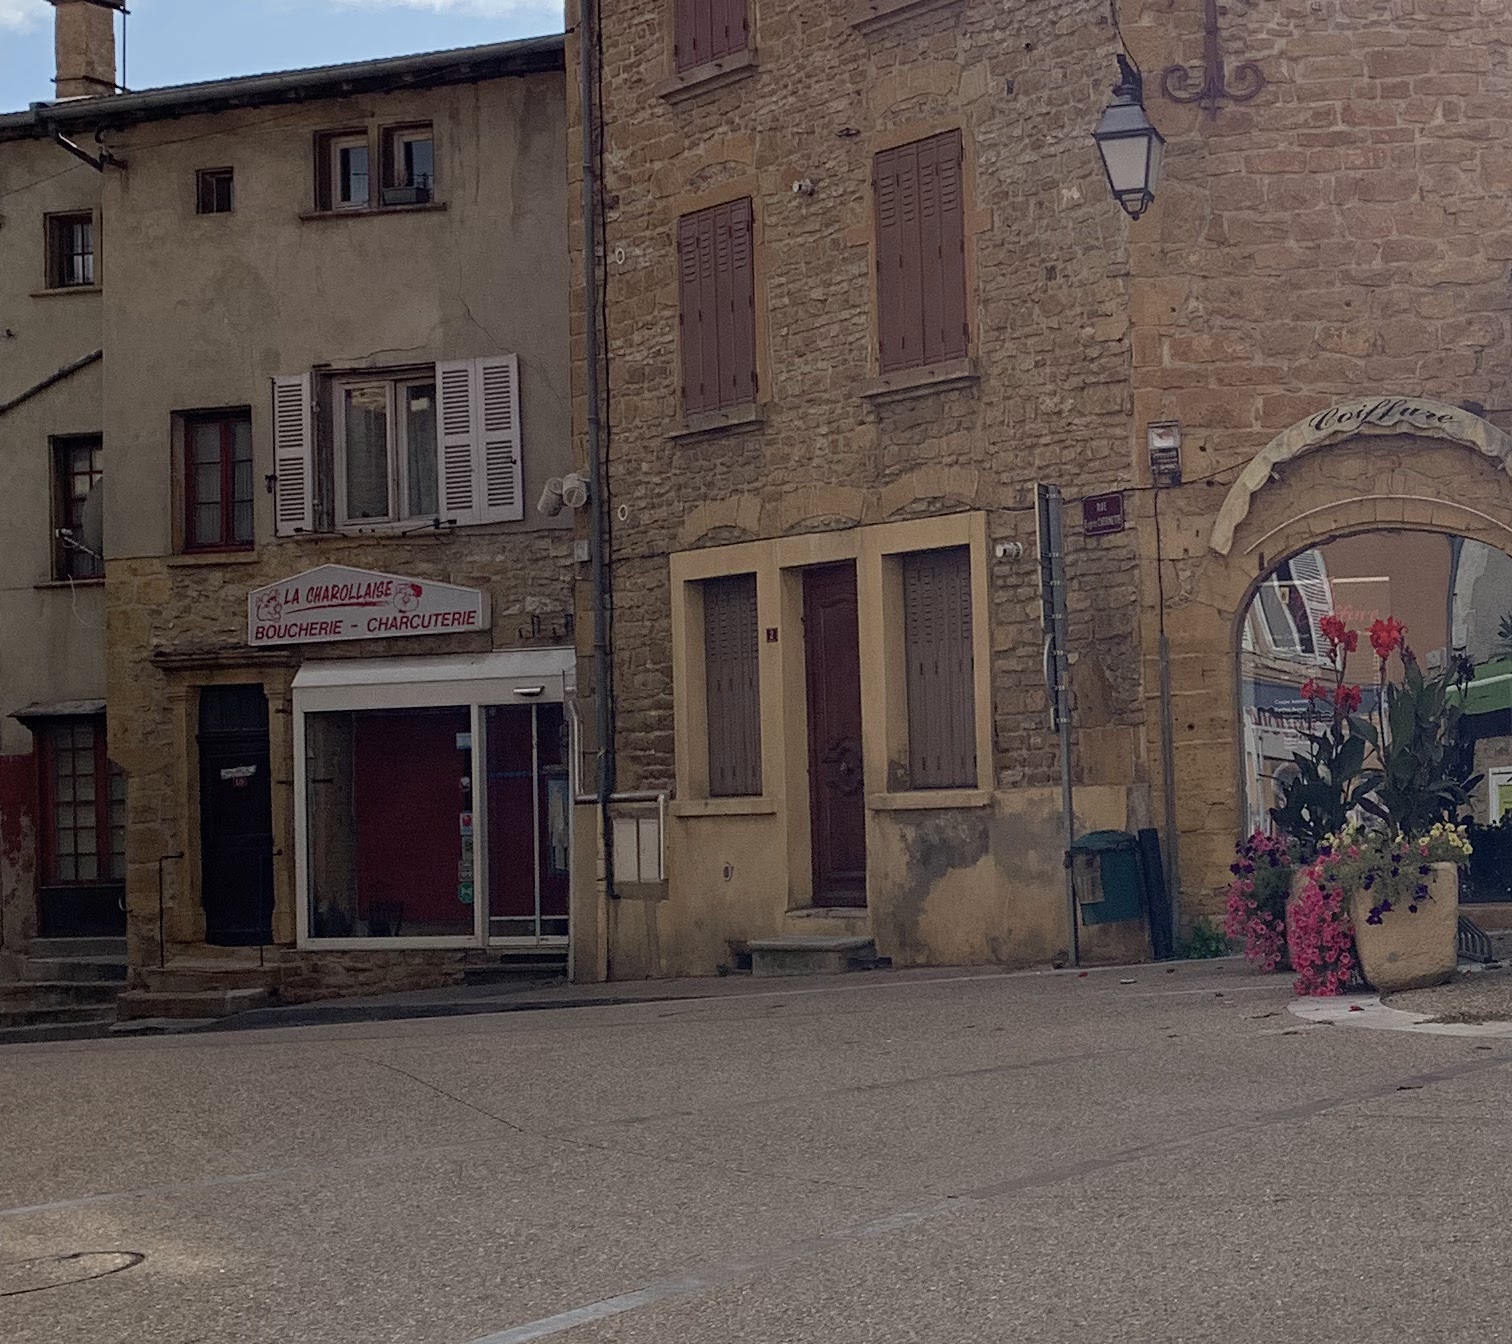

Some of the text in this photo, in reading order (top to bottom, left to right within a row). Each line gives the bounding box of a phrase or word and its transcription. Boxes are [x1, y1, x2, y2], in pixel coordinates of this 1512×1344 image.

[1308, 399, 1456, 431] Coiffure
[283, 580, 393, 605] LA CHAROLLAISE
[255, 620, 343, 640] BOUCHERIE
[367, 610, 477, 633] CHARCUTERIE
